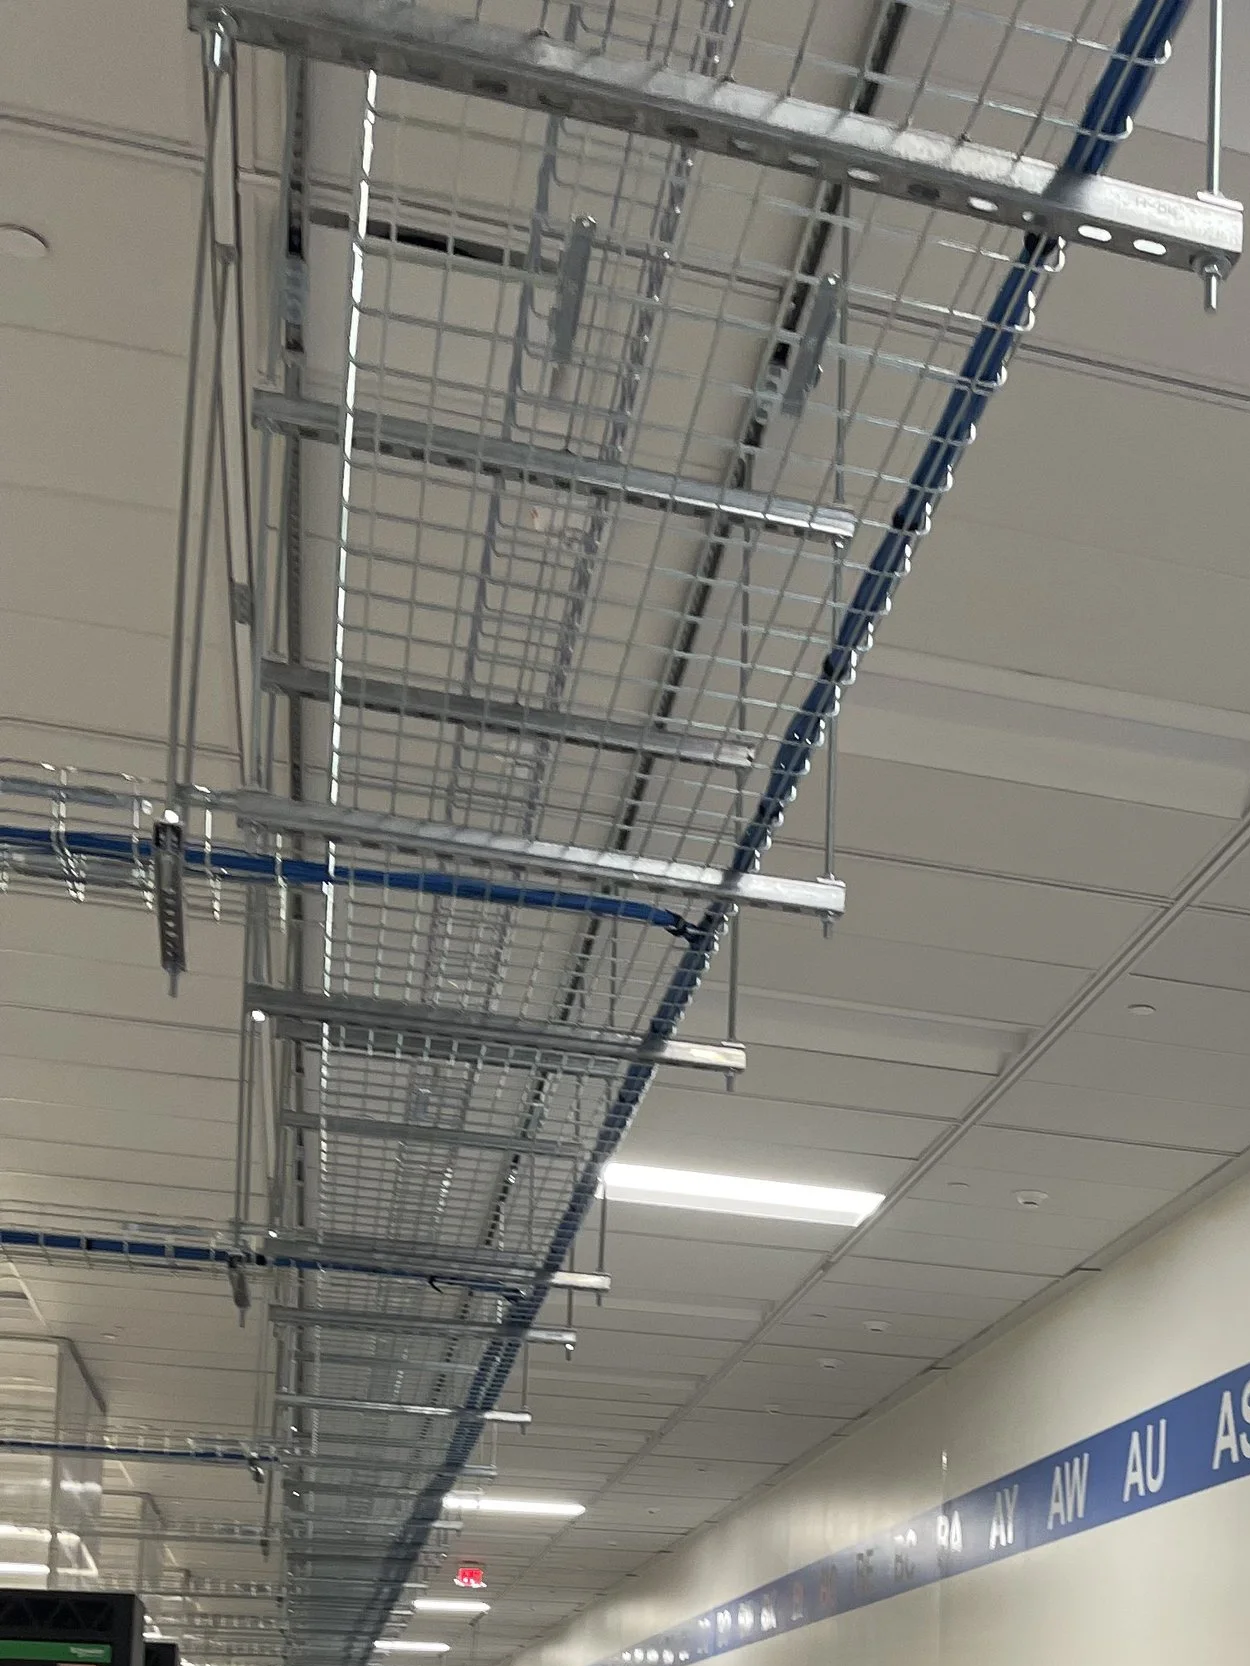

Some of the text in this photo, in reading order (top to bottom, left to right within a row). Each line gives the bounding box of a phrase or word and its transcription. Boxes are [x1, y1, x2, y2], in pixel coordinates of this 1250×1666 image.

[989, 1484, 1019, 1551] AY
[1047, 1452, 1090, 1530] AW
[1122, 1418, 1167, 1503] AU
